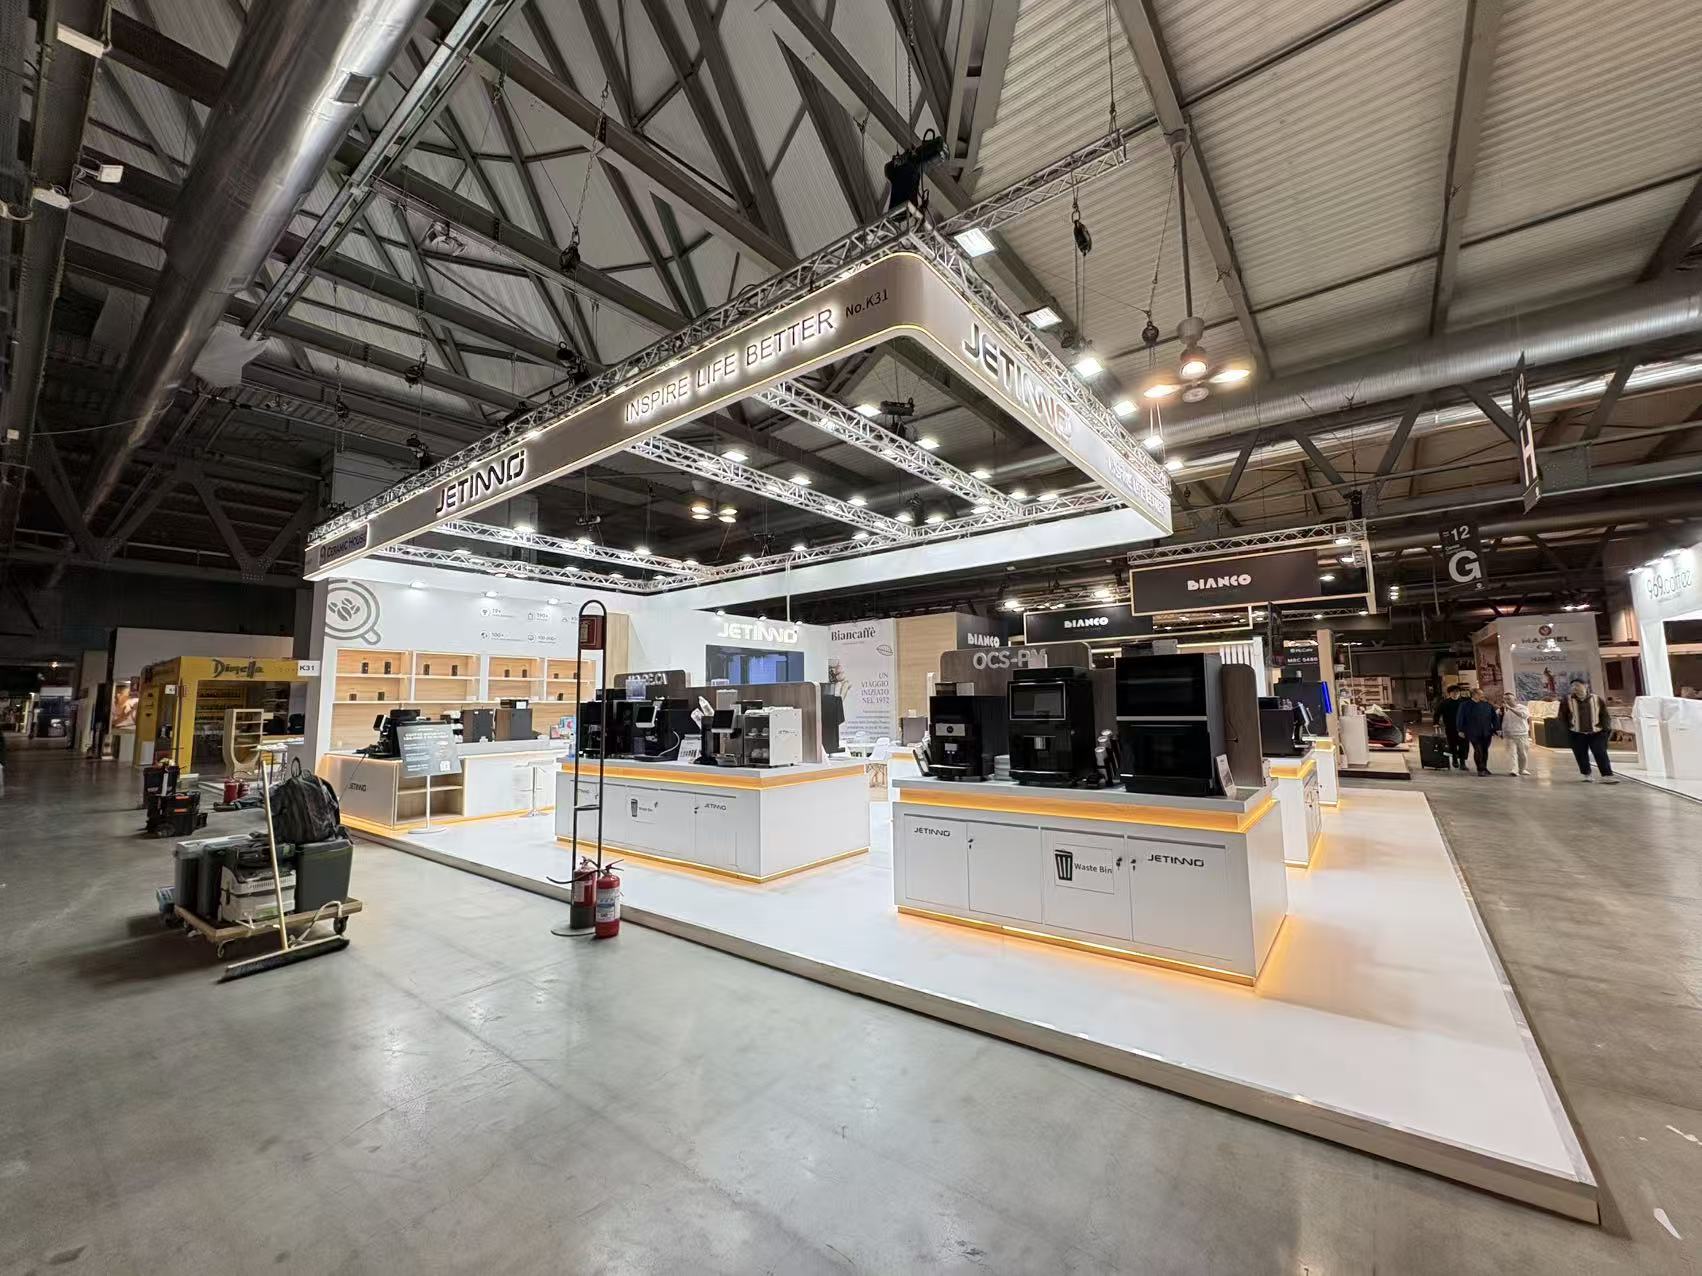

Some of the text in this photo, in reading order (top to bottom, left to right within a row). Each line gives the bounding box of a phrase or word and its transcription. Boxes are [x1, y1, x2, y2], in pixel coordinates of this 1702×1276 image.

[625, 288, 889, 423] INSPIRE LIFE BETTER No.K31
[435, 449, 526, 514] JETINNO
[1451, 525, 1470, 541] 12
[1448, 550, 1482, 583] G
[1187, 574, 1252, 591] BIANCO
[1064, 616, 1109, 629] BIANCO
[717, 622, 800, 644] JETINNO
[831, 627, 876, 641] Biancaffè
[967, 633, 1000, 648] BIANCO
[914, 827, 951, 837] JETINNO
[1074, 862, 1112, 874] Waste Bin
[1147, 854, 1205, 868] JETINNO
